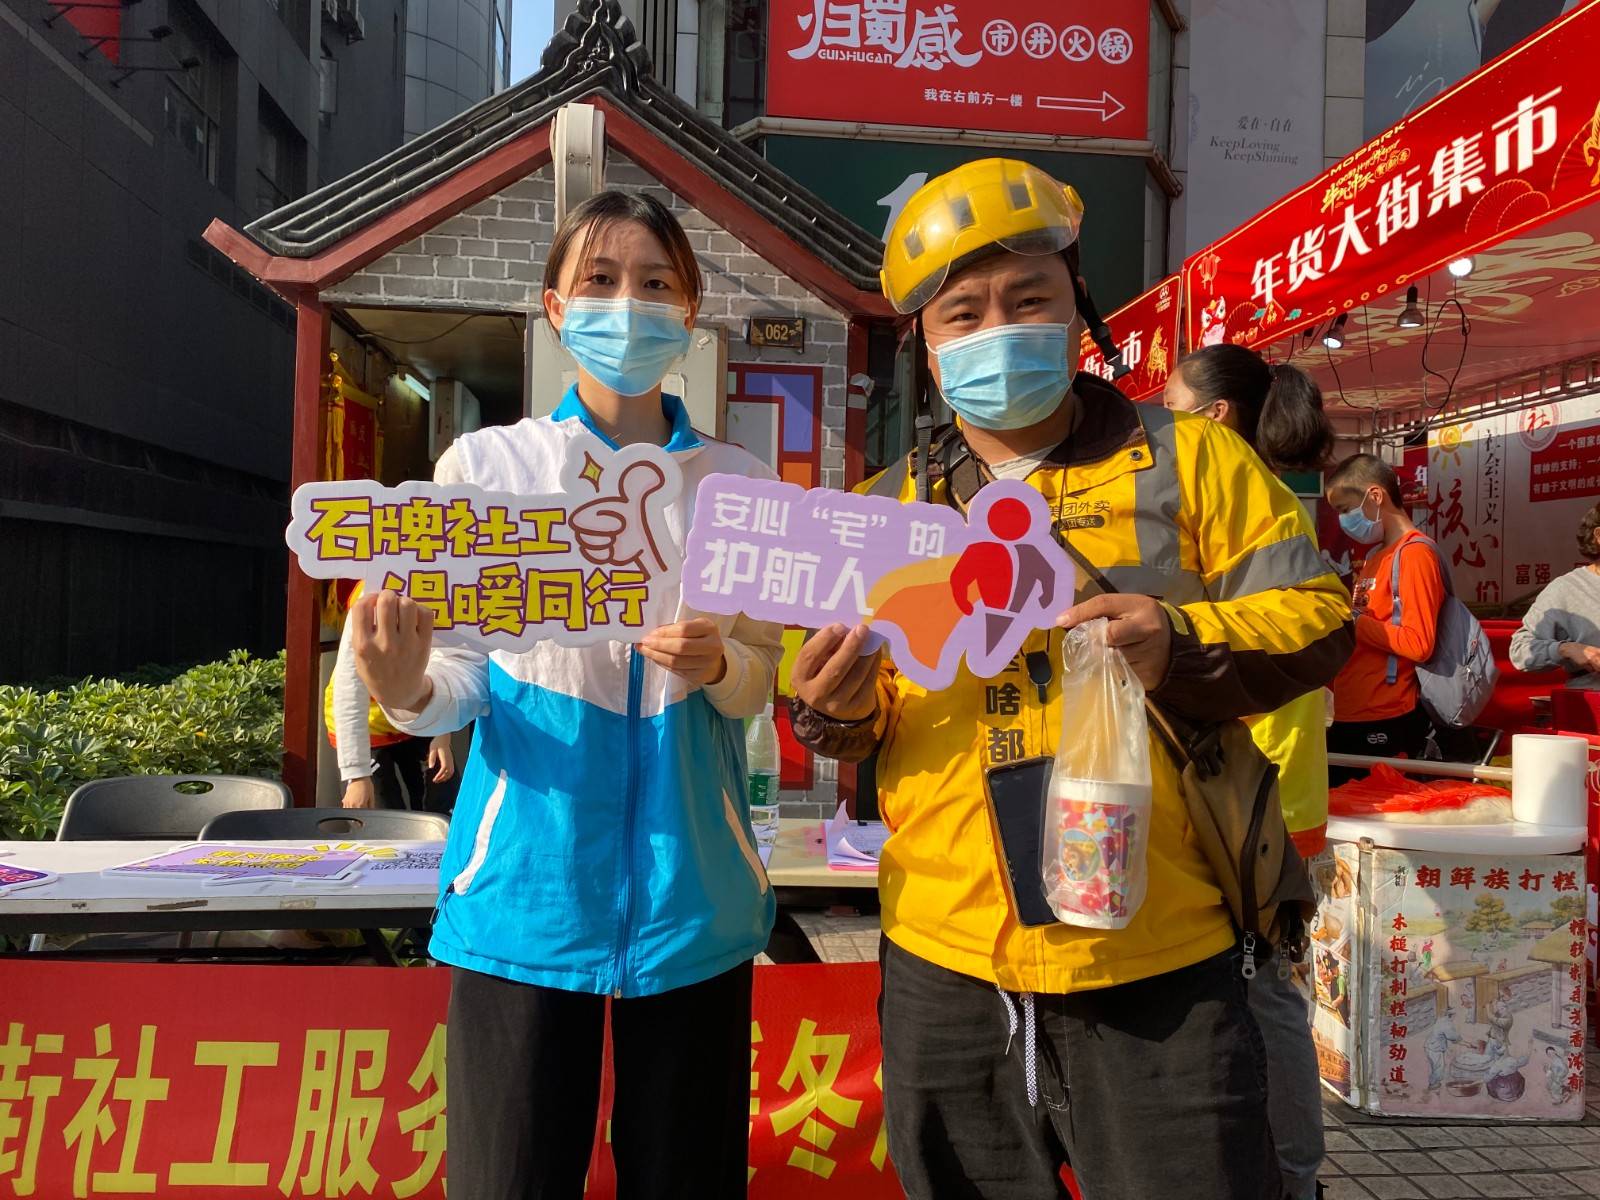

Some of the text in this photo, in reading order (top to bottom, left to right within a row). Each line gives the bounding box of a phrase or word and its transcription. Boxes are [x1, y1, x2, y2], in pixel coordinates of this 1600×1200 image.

[817, 49, 893, 65] GUISHUGAN
[985, 22, 1131, 62] 市井火锅
[923, 87, 1024, 108] 我在右前方一楼
[1330, 121, 1406, 177] MOPARK
[1251, 86, 1562, 303] 年货大街集市
[765, 324, 789, 340] 062
[305, 496, 572, 562] 石牌社工
[700, 538, 874, 616] 护航人
[1515, 564, 1550, 586] 富强
[985, 654, 1025, 763] 啥都
